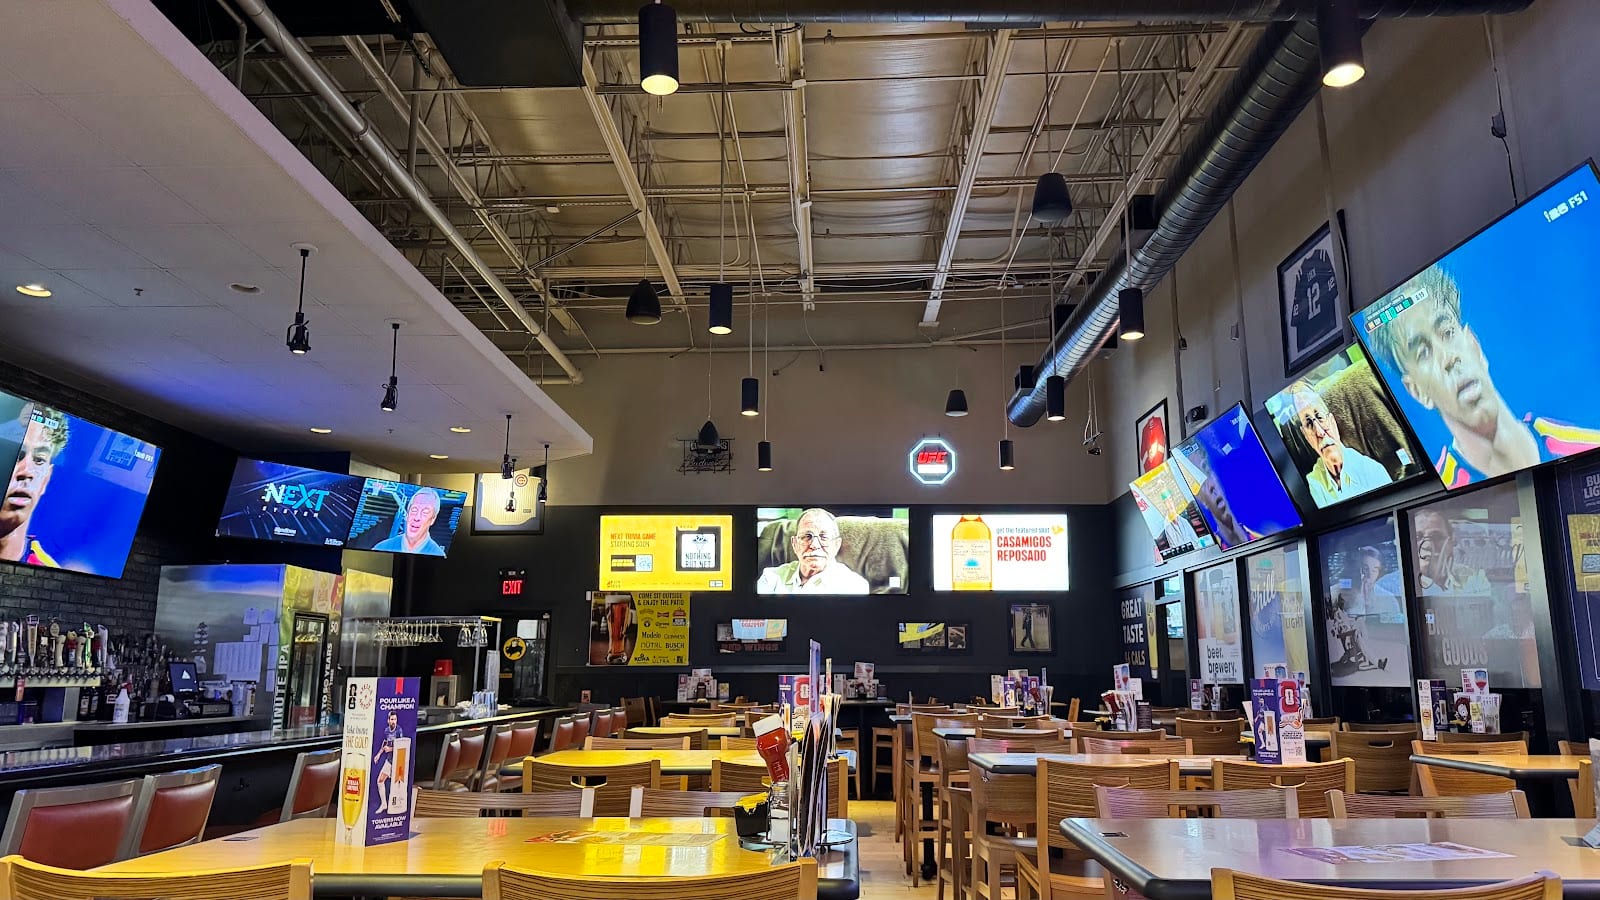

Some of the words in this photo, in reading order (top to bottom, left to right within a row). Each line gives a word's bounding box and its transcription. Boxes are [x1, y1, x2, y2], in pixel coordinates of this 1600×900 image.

[1568, 190, 1588, 209] FS1
[1306, 282, 1321, 320] 12
[917, 450, 948, 465] UFC
[1586, 474, 1600, 487] BU
[261, 483, 330, 511] NEXT
[1583, 486, 1600, 499] LIG
[997, 536, 1052, 548] CASAMIGOS
[685, 552, 712, 560] NOTHING
[997, 549, 1047, 561] REPOSADO
[502, 580, 523, 595] EXIT
[1121, 597, 1142, 619] GREAT
[641, 631, 662, 639] Modelo
[1123, 623, 1144, 644] TASTE
[278, 643, 290, 670] IPA
[1207, 645, 1224, 659] beer.
[324, 642, 333, 677] YEARS
[1208, 660, 1237, 677] brewery.
[321, 695, 328, 709] TO
[380, 697, 397, 705] POUR
[380, 703, 415, 711] CHAMPION
